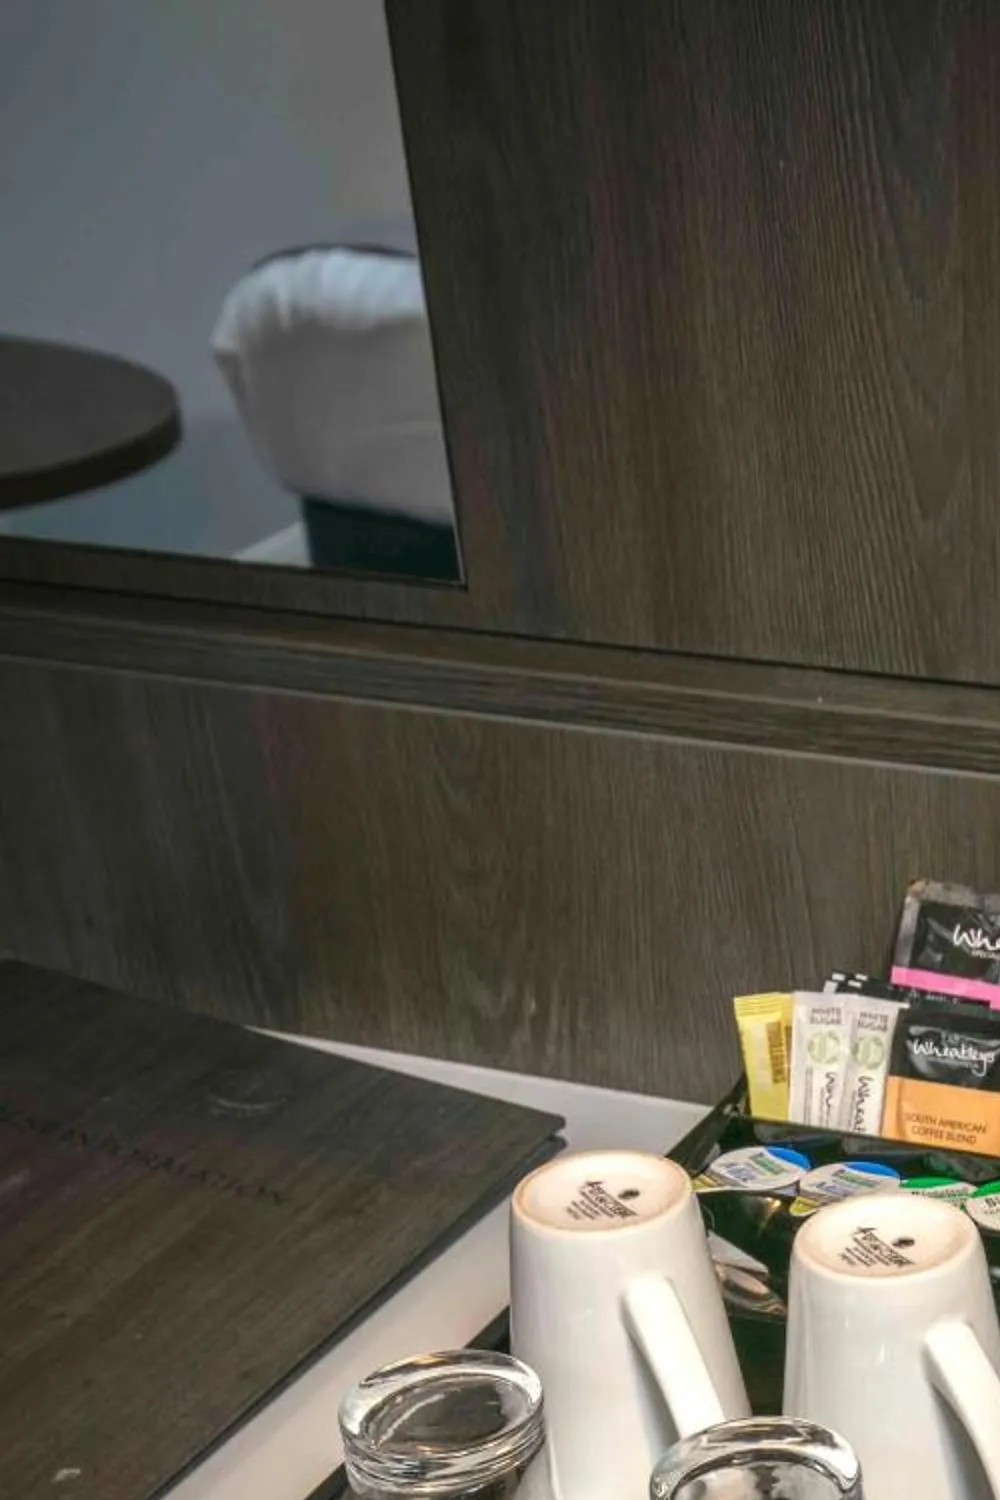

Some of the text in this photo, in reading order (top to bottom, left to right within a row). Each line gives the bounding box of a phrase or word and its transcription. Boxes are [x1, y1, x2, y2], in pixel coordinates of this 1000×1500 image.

[912, 1039, 995, 1077] Wheatleys
[906, 1112, 989, 1134] SOUTH AMERICAN
